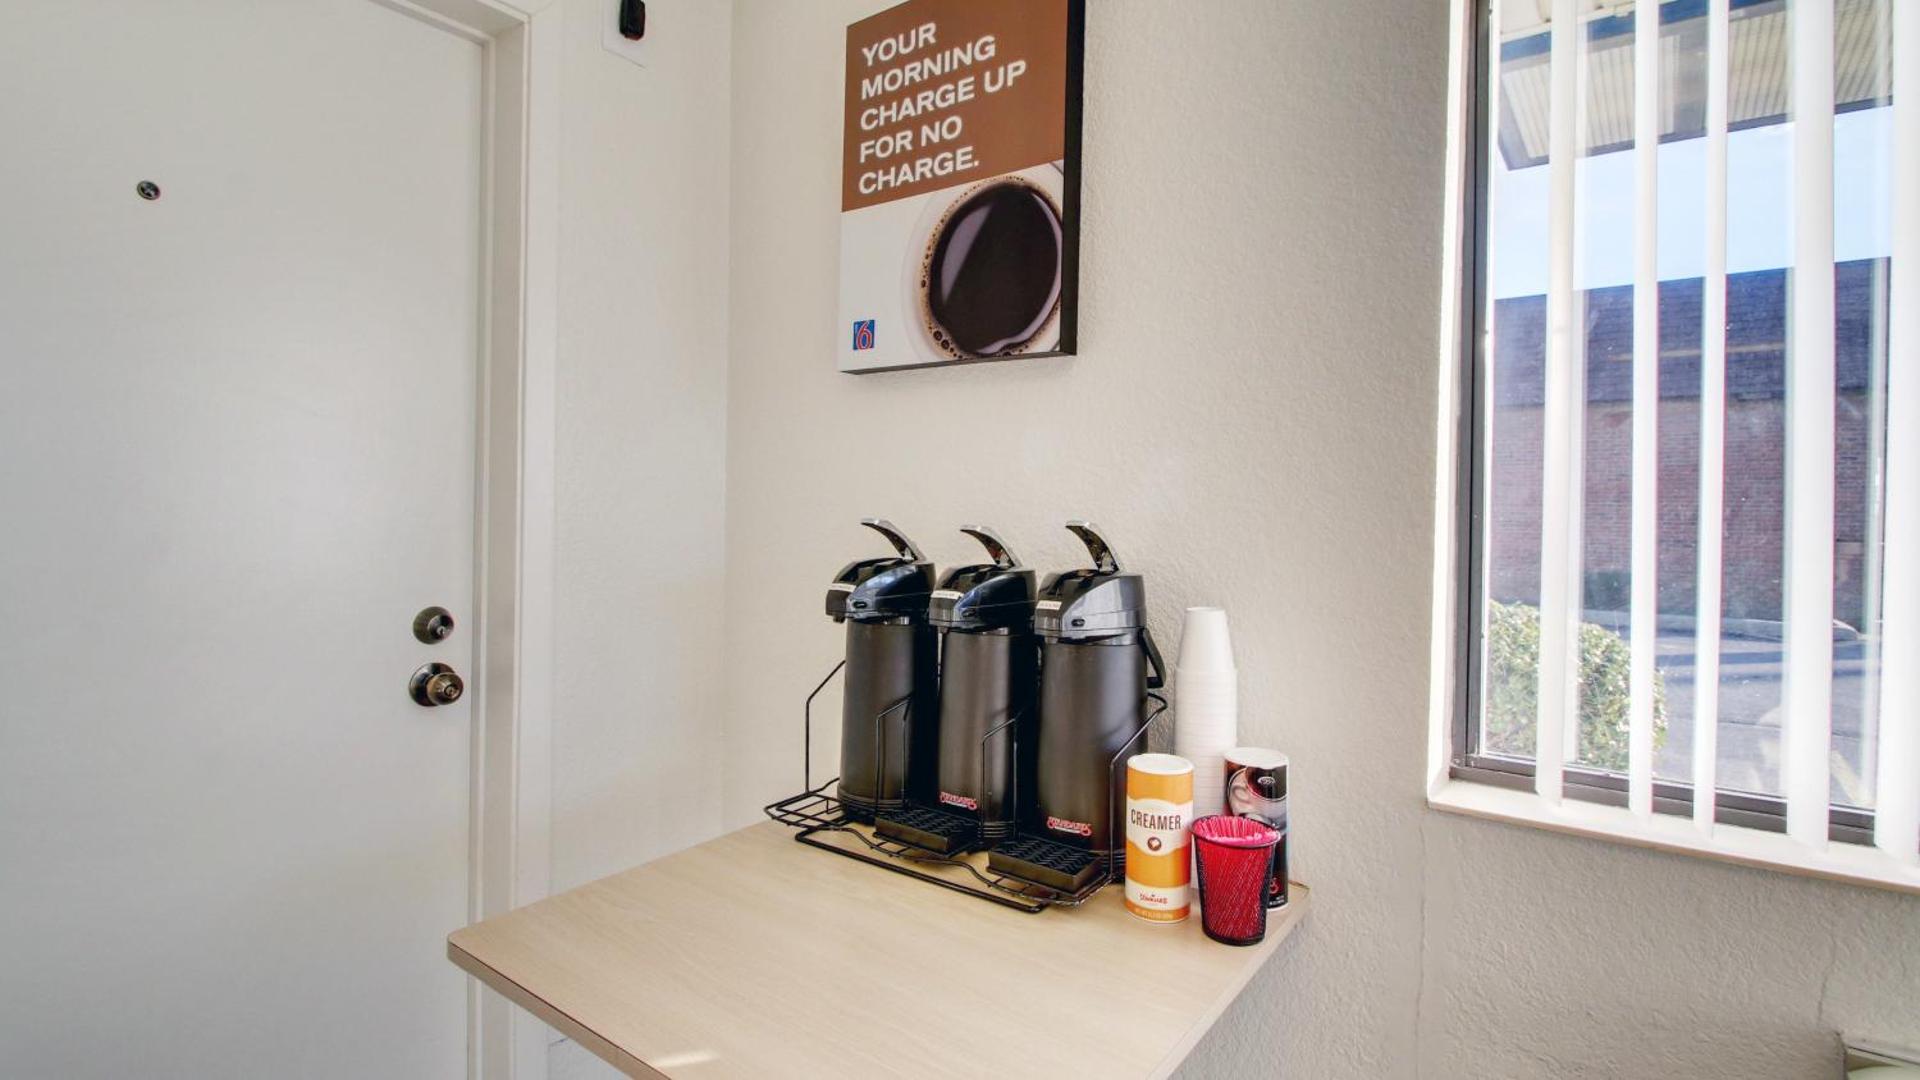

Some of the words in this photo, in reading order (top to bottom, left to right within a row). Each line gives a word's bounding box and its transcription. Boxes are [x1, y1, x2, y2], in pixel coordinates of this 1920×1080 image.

[861, 22, 937, 68] YOUR
[861, 35, 997, 100] MORNING
[859, 76, 976, 131] CHARGE
[983, 60, 1027, 94] UP
[859, 130, 913, 164] FOR
[920, 115, 963, 147] NO
[857, 145, 980, 195] CHARGE.
[855, 320, 873, 350] 6
[1130, 808, 1181, 831] CREAMER
